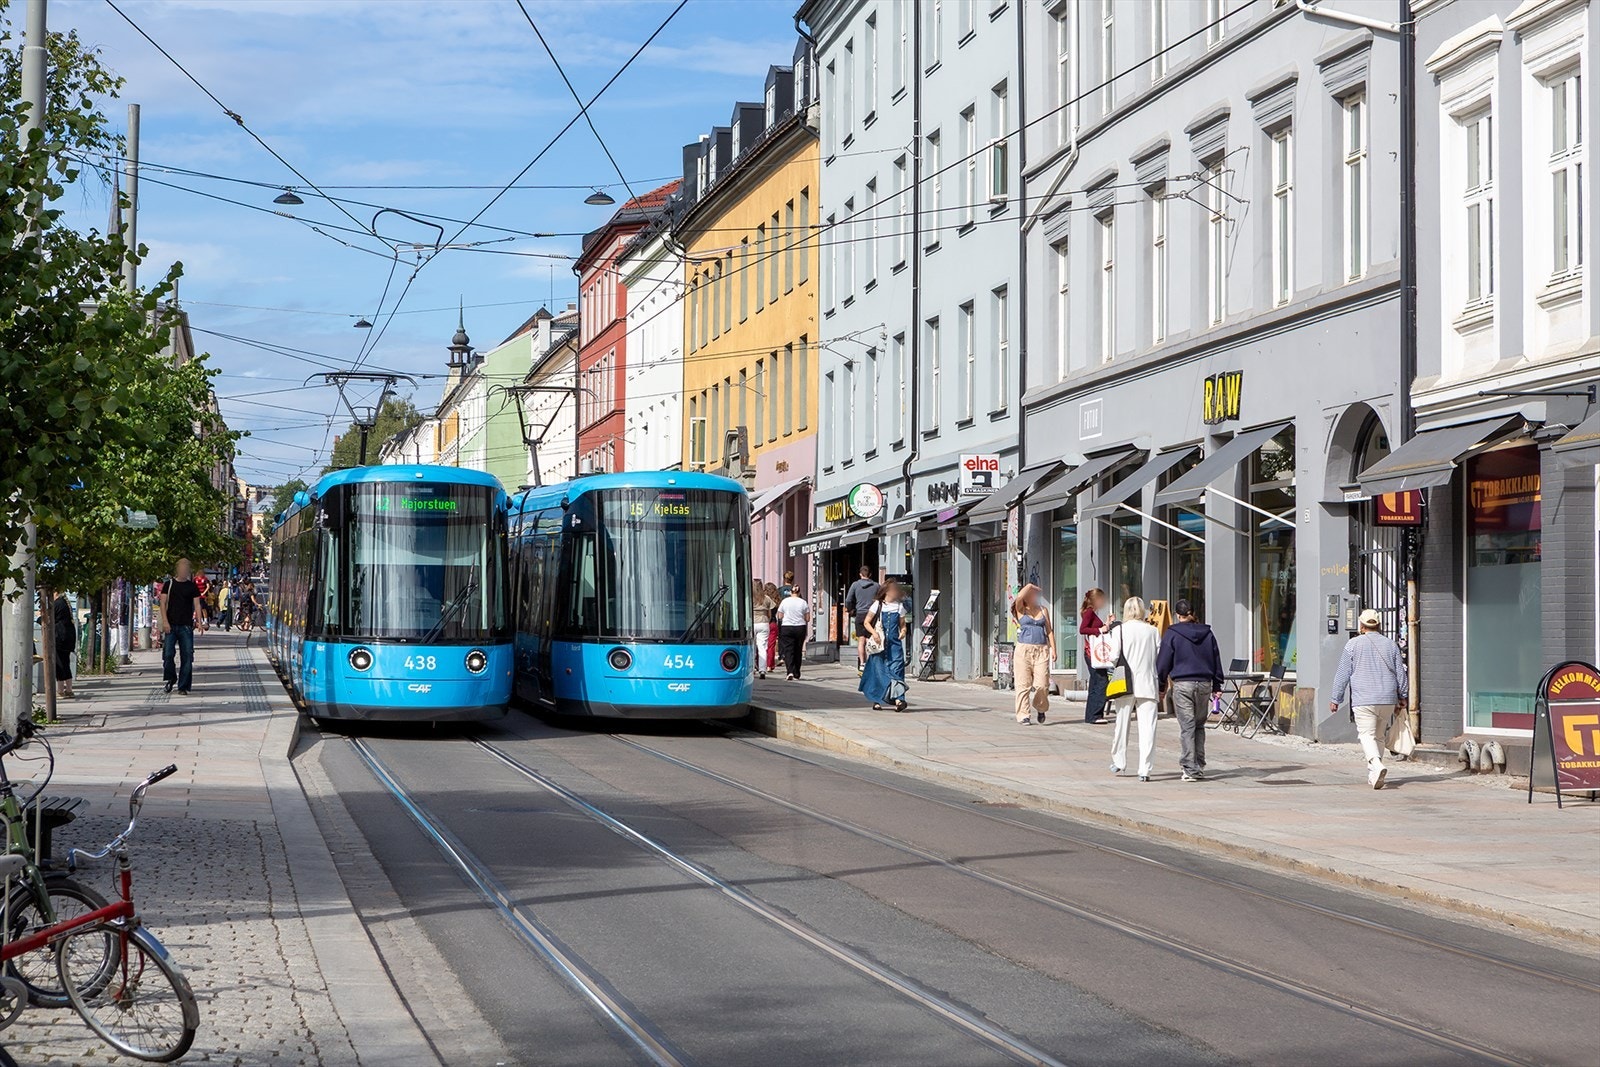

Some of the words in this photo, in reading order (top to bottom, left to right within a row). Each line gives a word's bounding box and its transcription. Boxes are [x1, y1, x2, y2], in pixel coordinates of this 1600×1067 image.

[1204, 373, 1241, 421] RAW
[964, 456, 998, 470] elna
[1483, 474, 1541, 497] TOBAKKLAND
[401, 498, 456, 511] Majorstuen
[630, 503, 643, 515] 15
[404, 655, 437, 670] 438
[663, 654, 695, 669] 454
